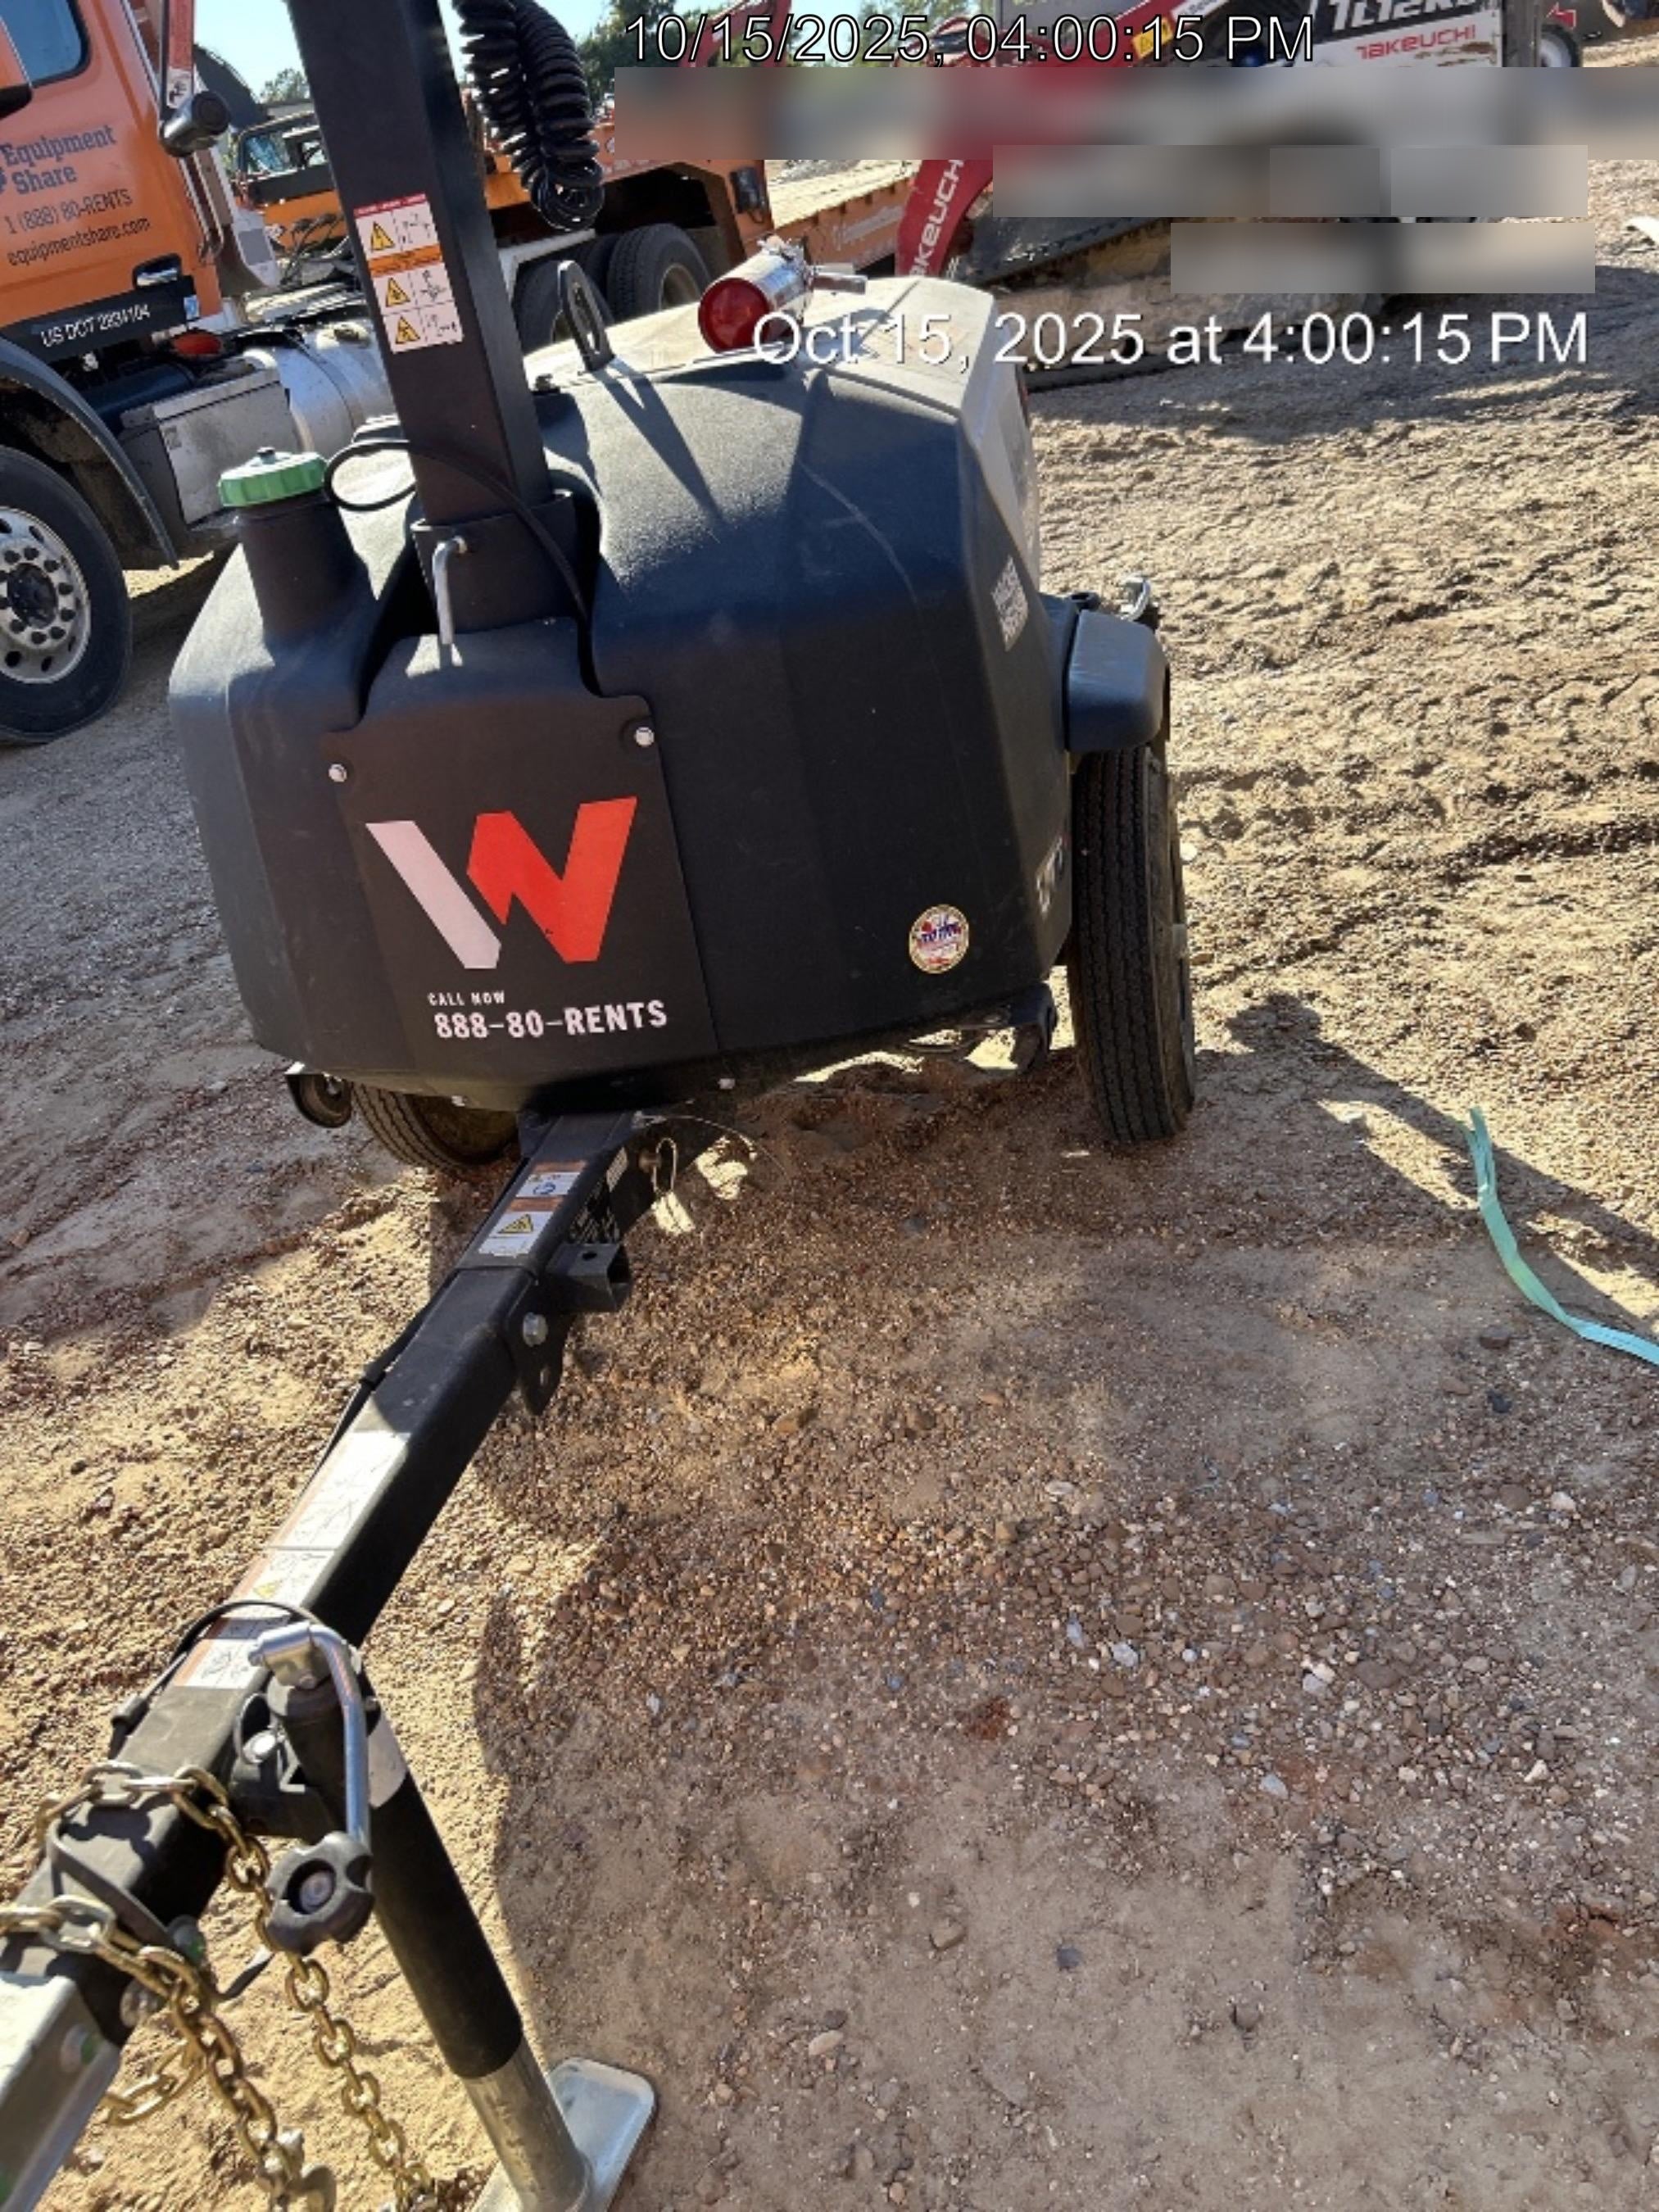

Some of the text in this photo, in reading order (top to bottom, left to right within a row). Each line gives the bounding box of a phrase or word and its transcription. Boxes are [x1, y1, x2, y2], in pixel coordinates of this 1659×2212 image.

[1, 125, 116, 167] Equipment
[11, 165, 77, 194] Share
[5, 188, 133, 234] 1 (888) 80-RENTS
[7, 217, 150, 266] equipmentshare.com
[41, 326, 64, 347] US
[66, 315, 94, 340] DOT
[428, 990, 505, 1007] CALL NOW
[433, 999, 668, 1039] 888-80-RENTS
